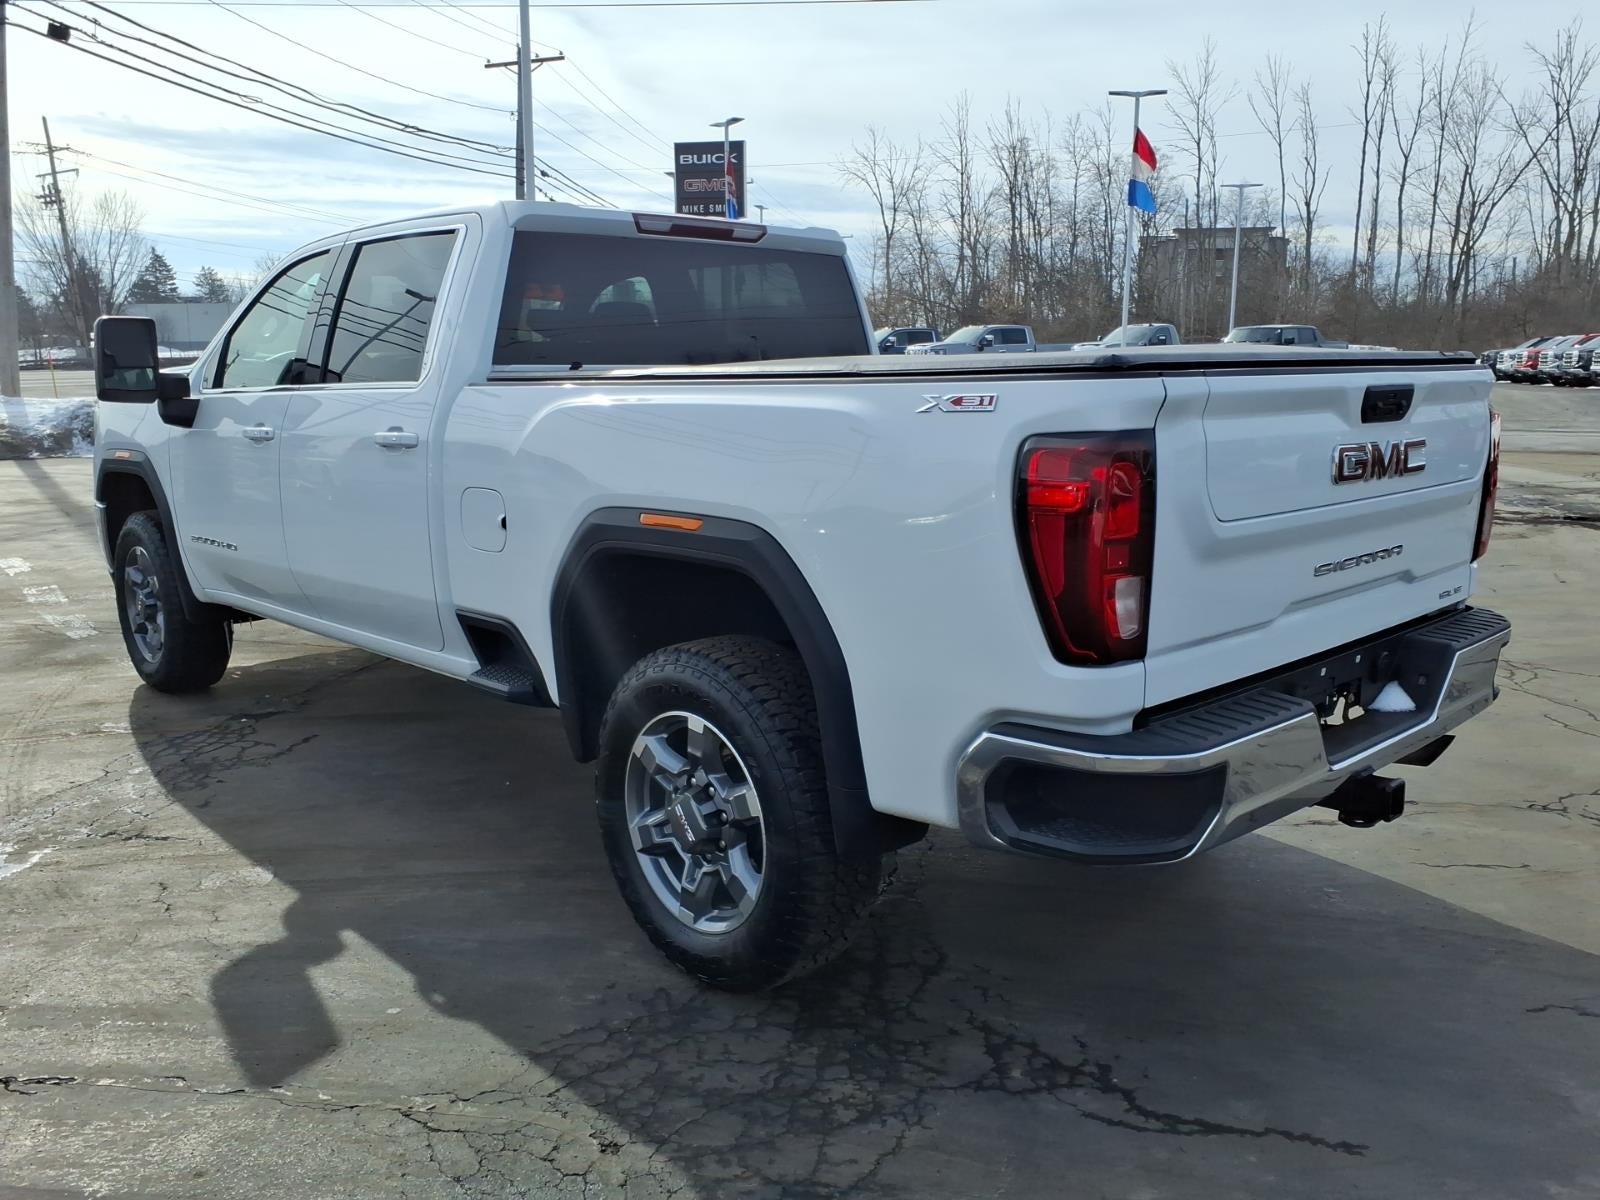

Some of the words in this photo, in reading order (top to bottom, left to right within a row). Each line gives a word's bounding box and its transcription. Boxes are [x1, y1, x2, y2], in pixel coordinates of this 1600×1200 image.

[680, 153, 738, 164] BUICK
[682, 204, 705, 213] MIKE
[1331, 437, 1427, 485] GMC
[1314, 544, 1404, 577] SIERRA
